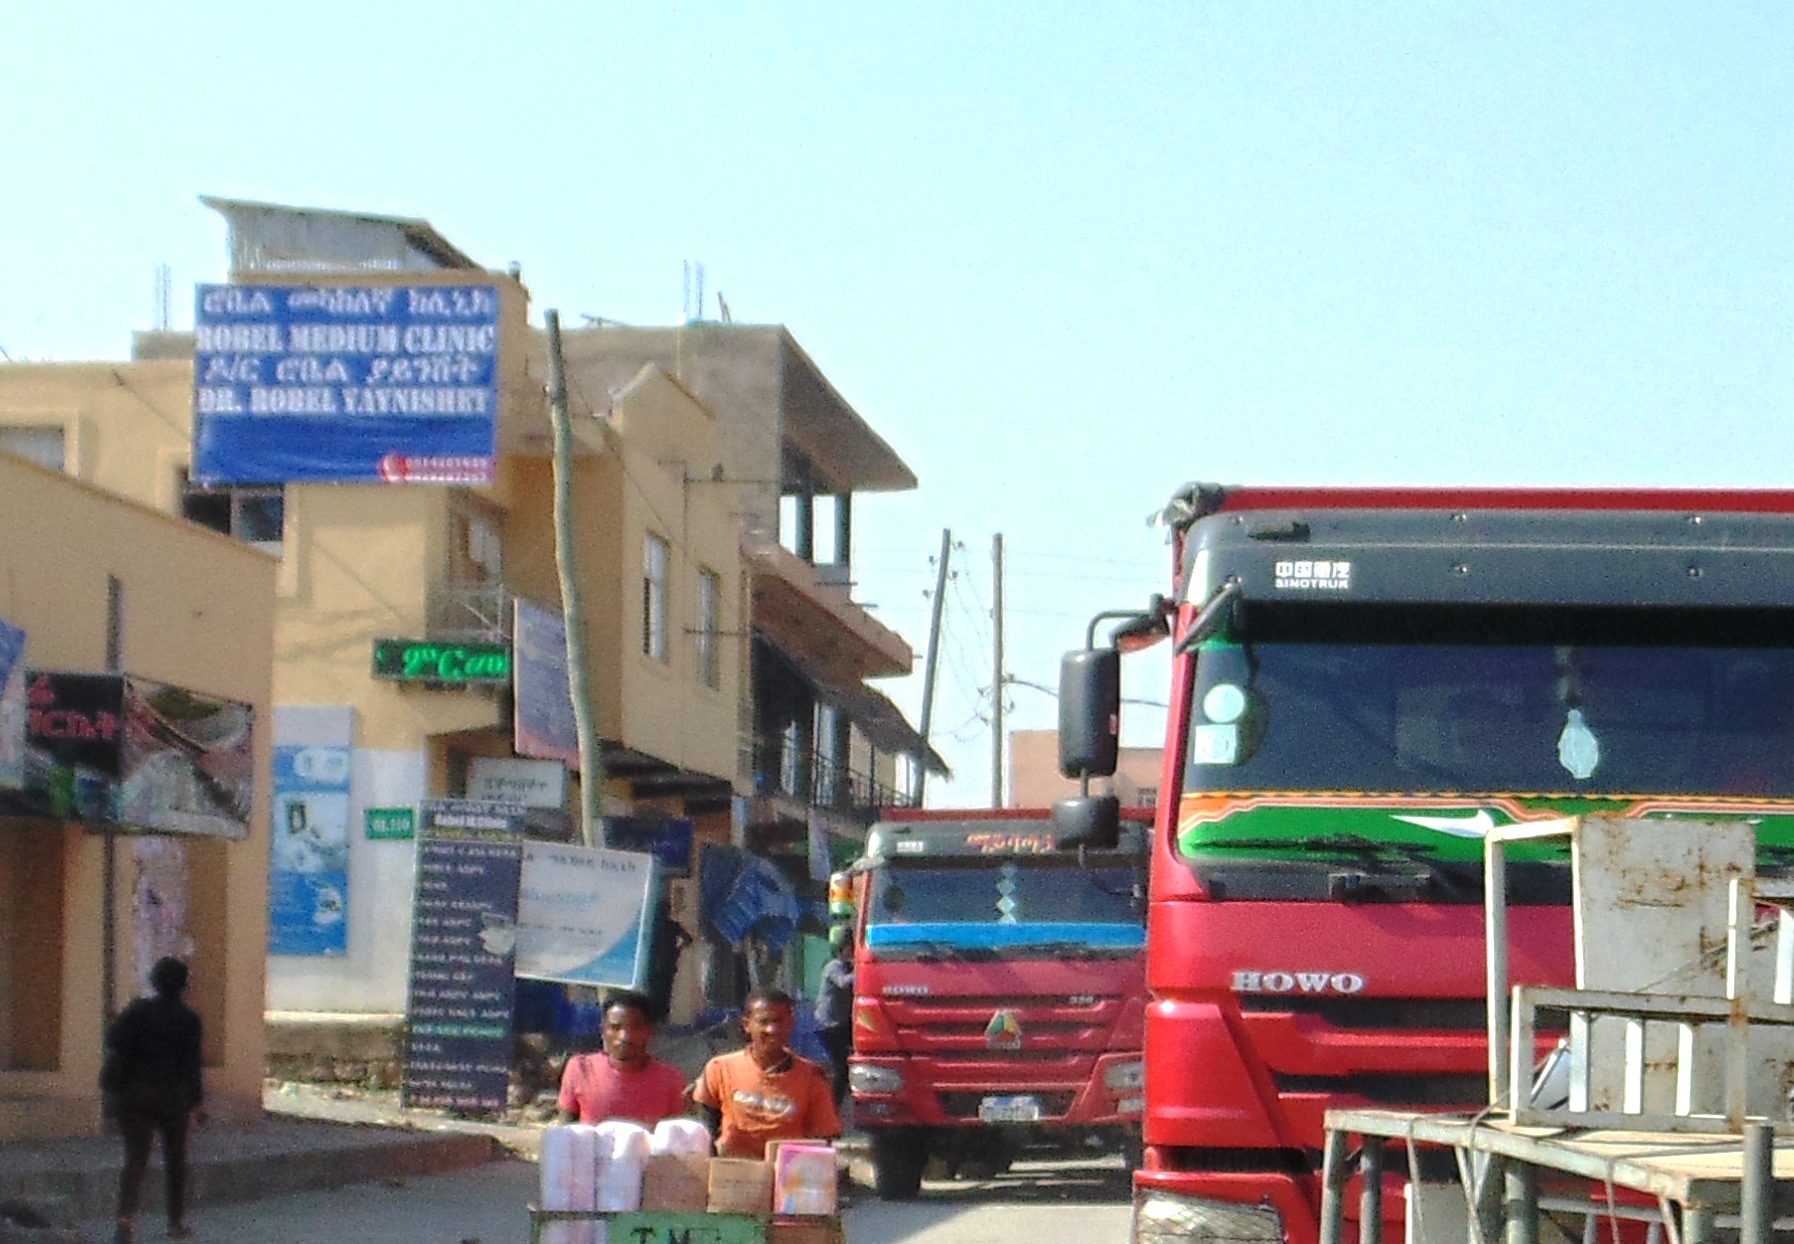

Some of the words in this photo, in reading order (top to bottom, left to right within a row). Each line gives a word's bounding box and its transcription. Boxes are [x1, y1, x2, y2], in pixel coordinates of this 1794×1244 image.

[199, 324, 284, 352] ROBEL
[290, 324, 397, 353] MEDIUM
[404, 324, 494, 354] CLINIC
[198, 387, 243, 413] DR.
[249, 387, 337, 414] ROBEL
[1274, 561, 1351, 578] 中国重汽
[1274, 579, 1349, 589] SINOTRUK
[1231, 971, 1365, 994] HOWO
